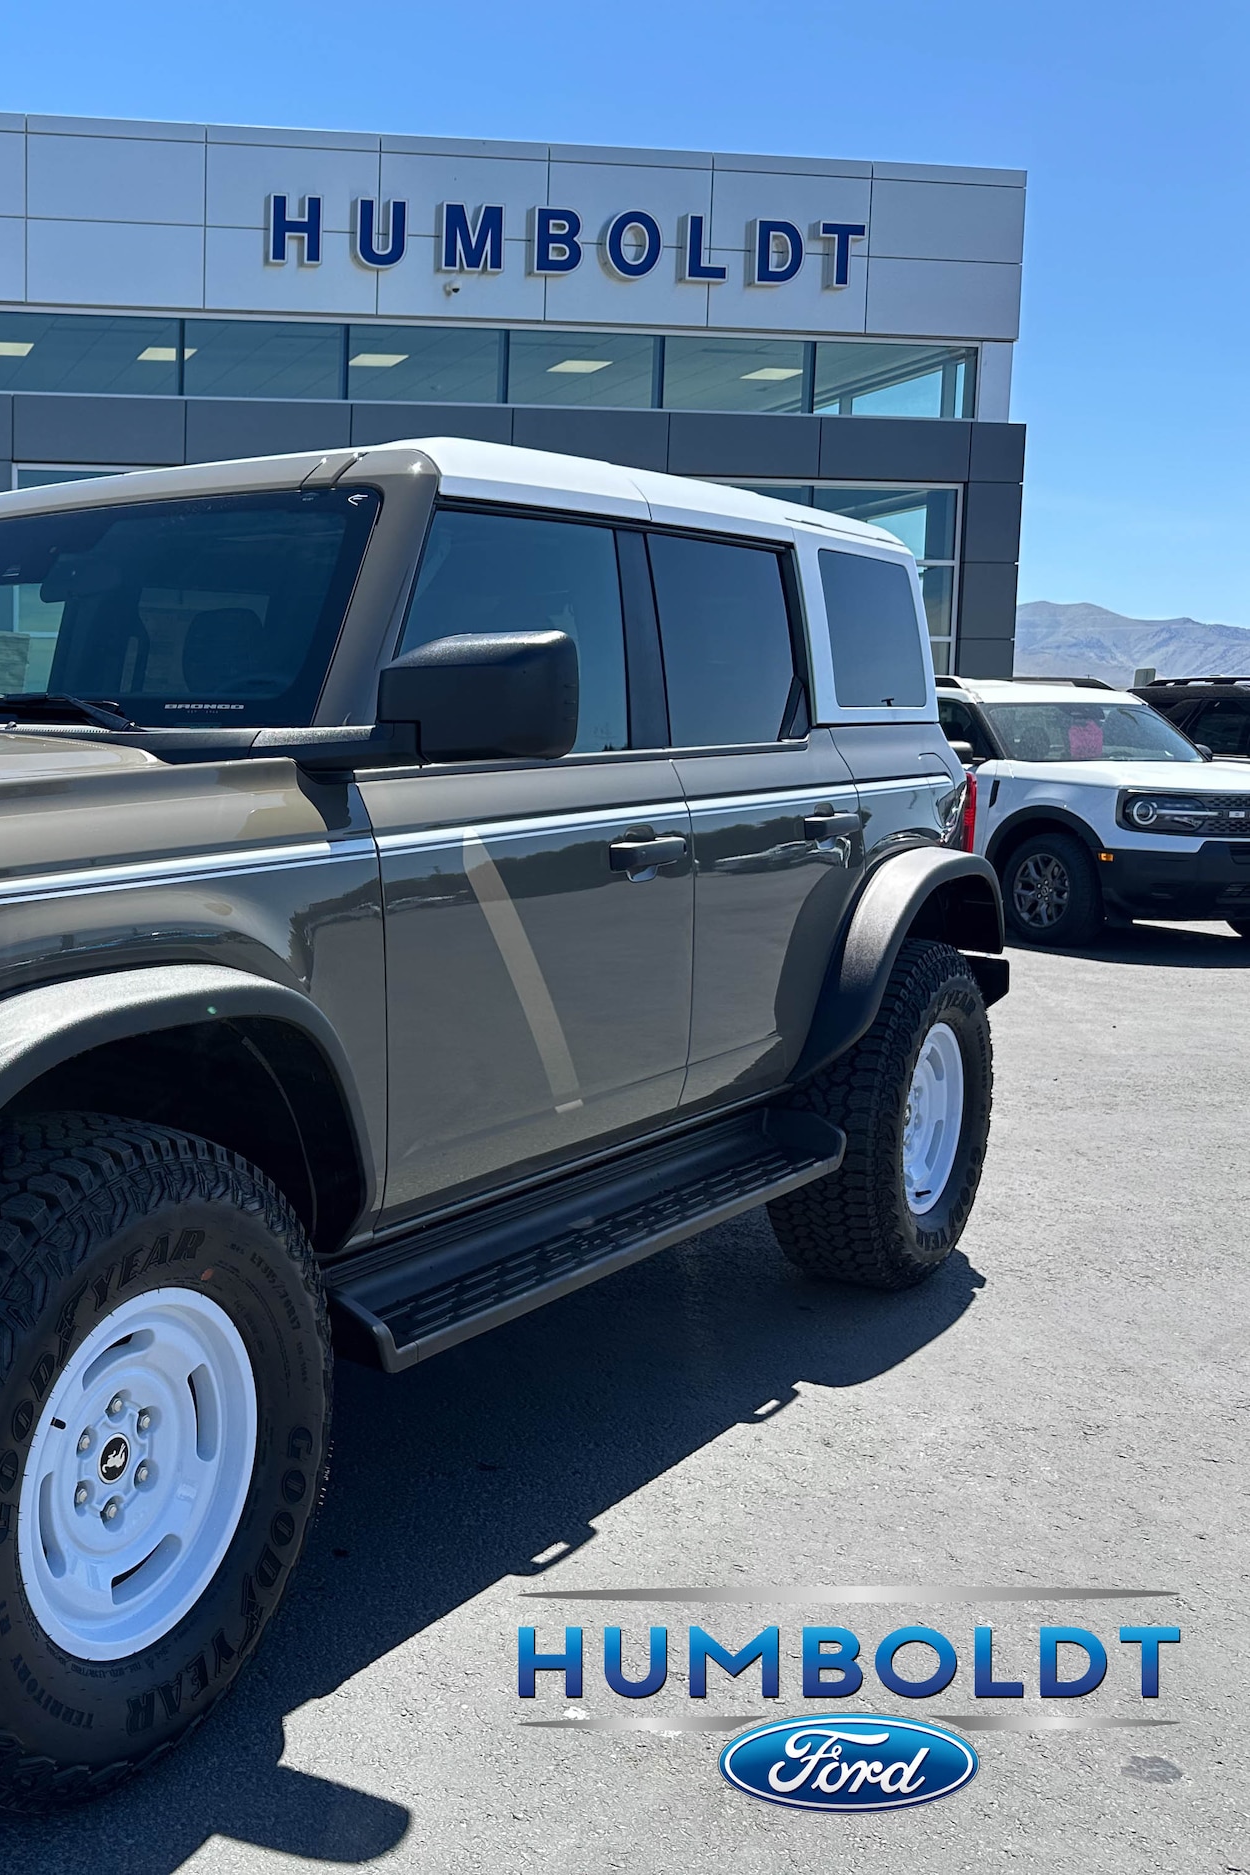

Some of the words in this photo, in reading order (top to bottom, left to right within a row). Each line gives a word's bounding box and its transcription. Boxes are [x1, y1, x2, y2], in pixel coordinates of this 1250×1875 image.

[265, 192, 867, 290] HUMBOLDT
[163, 703, 245, 711] BRONCO
[126, 1426, 313, 1737] GOODYEAR
[10, 1652, 95, 1730] TERRITORY
